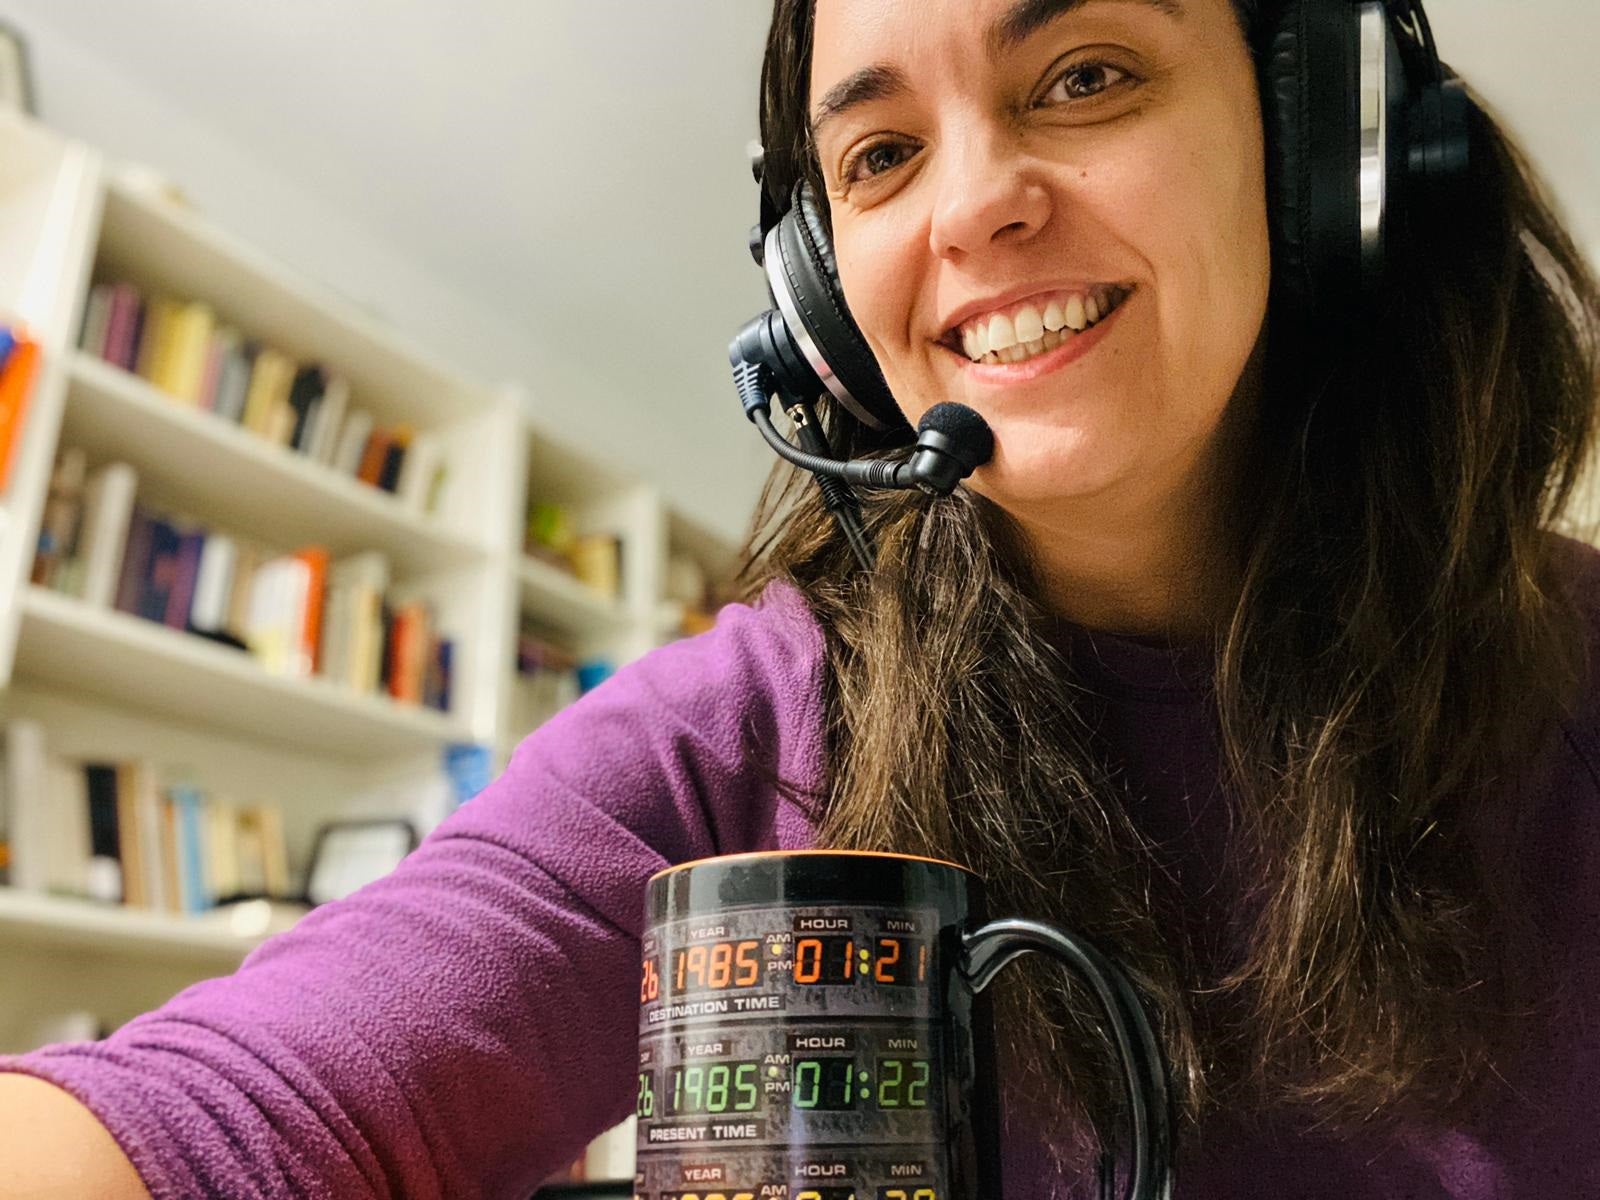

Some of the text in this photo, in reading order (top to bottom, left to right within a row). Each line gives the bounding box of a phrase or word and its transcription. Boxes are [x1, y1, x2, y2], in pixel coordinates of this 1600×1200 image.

[800, 918, 848, 931] HOUR
[887, 920, 916, 932] MIN
[690, 926, 725, 939] YEAR
[766, 933, 791, 944] AM
[677, 941, 759, 989] 1985
[767, 960, 792, 972] PM
[649, 996, 780, 1023] DESTINATION TIME
[796, 1037, 846, 1048] HOUR
[888, 1039, 918, 1049] MIN
[687, 1043, 723, 1056] YEAR
[764, 1054, 790, 1065] AM
[673, 1064, 757, 1112] 1985
[765, 1081, 790, 1093] PM
[650, 1125, 757, 1141] PRESENT TIME
[684, 1168, 721, 1180] YEAR
[795, 1164, 846, 1176] HOUR
[891, 1165, 922, 1176] MIN
[761, 1184, 787, 1196] AM
